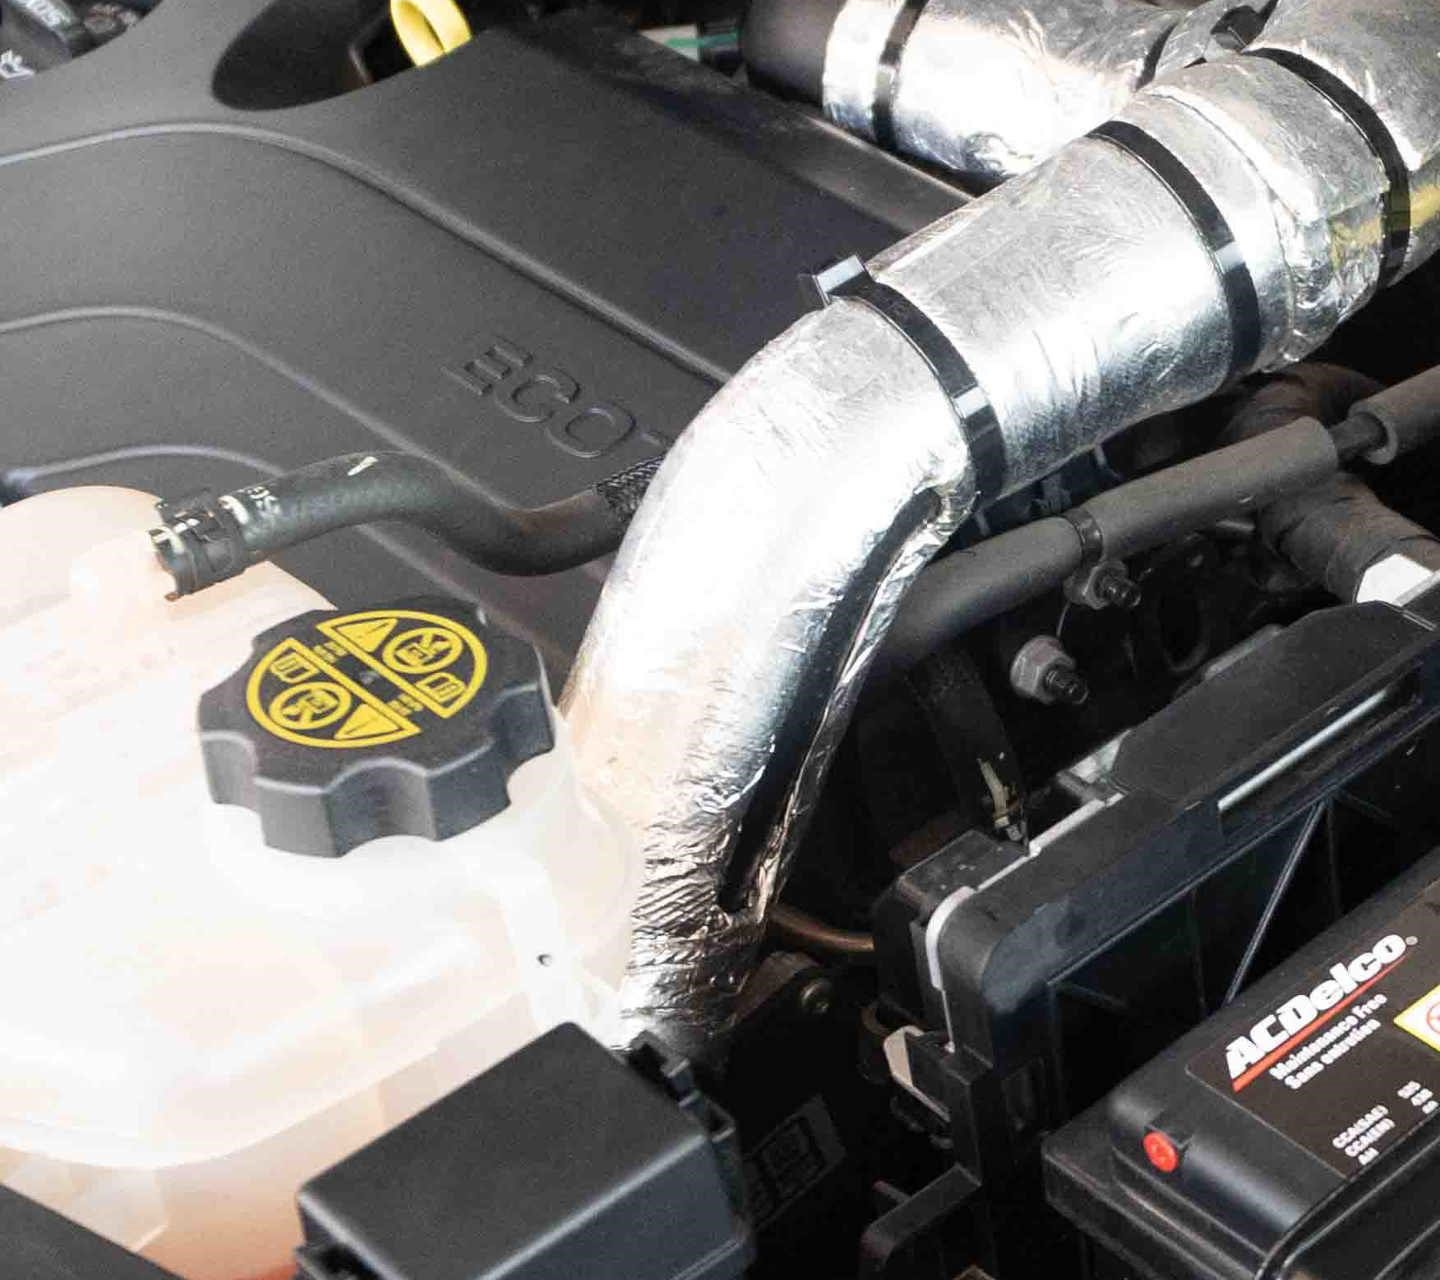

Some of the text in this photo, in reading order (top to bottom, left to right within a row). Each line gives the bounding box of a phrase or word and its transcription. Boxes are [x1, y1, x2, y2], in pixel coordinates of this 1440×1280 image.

[440, 332, 668, 461] ECO
[1225, 934, 1407, 1080] ACDelco
[1268, 993, 1388, 1081] Maintenance Free
[1284, 1060, 1325, 1090] Sans
